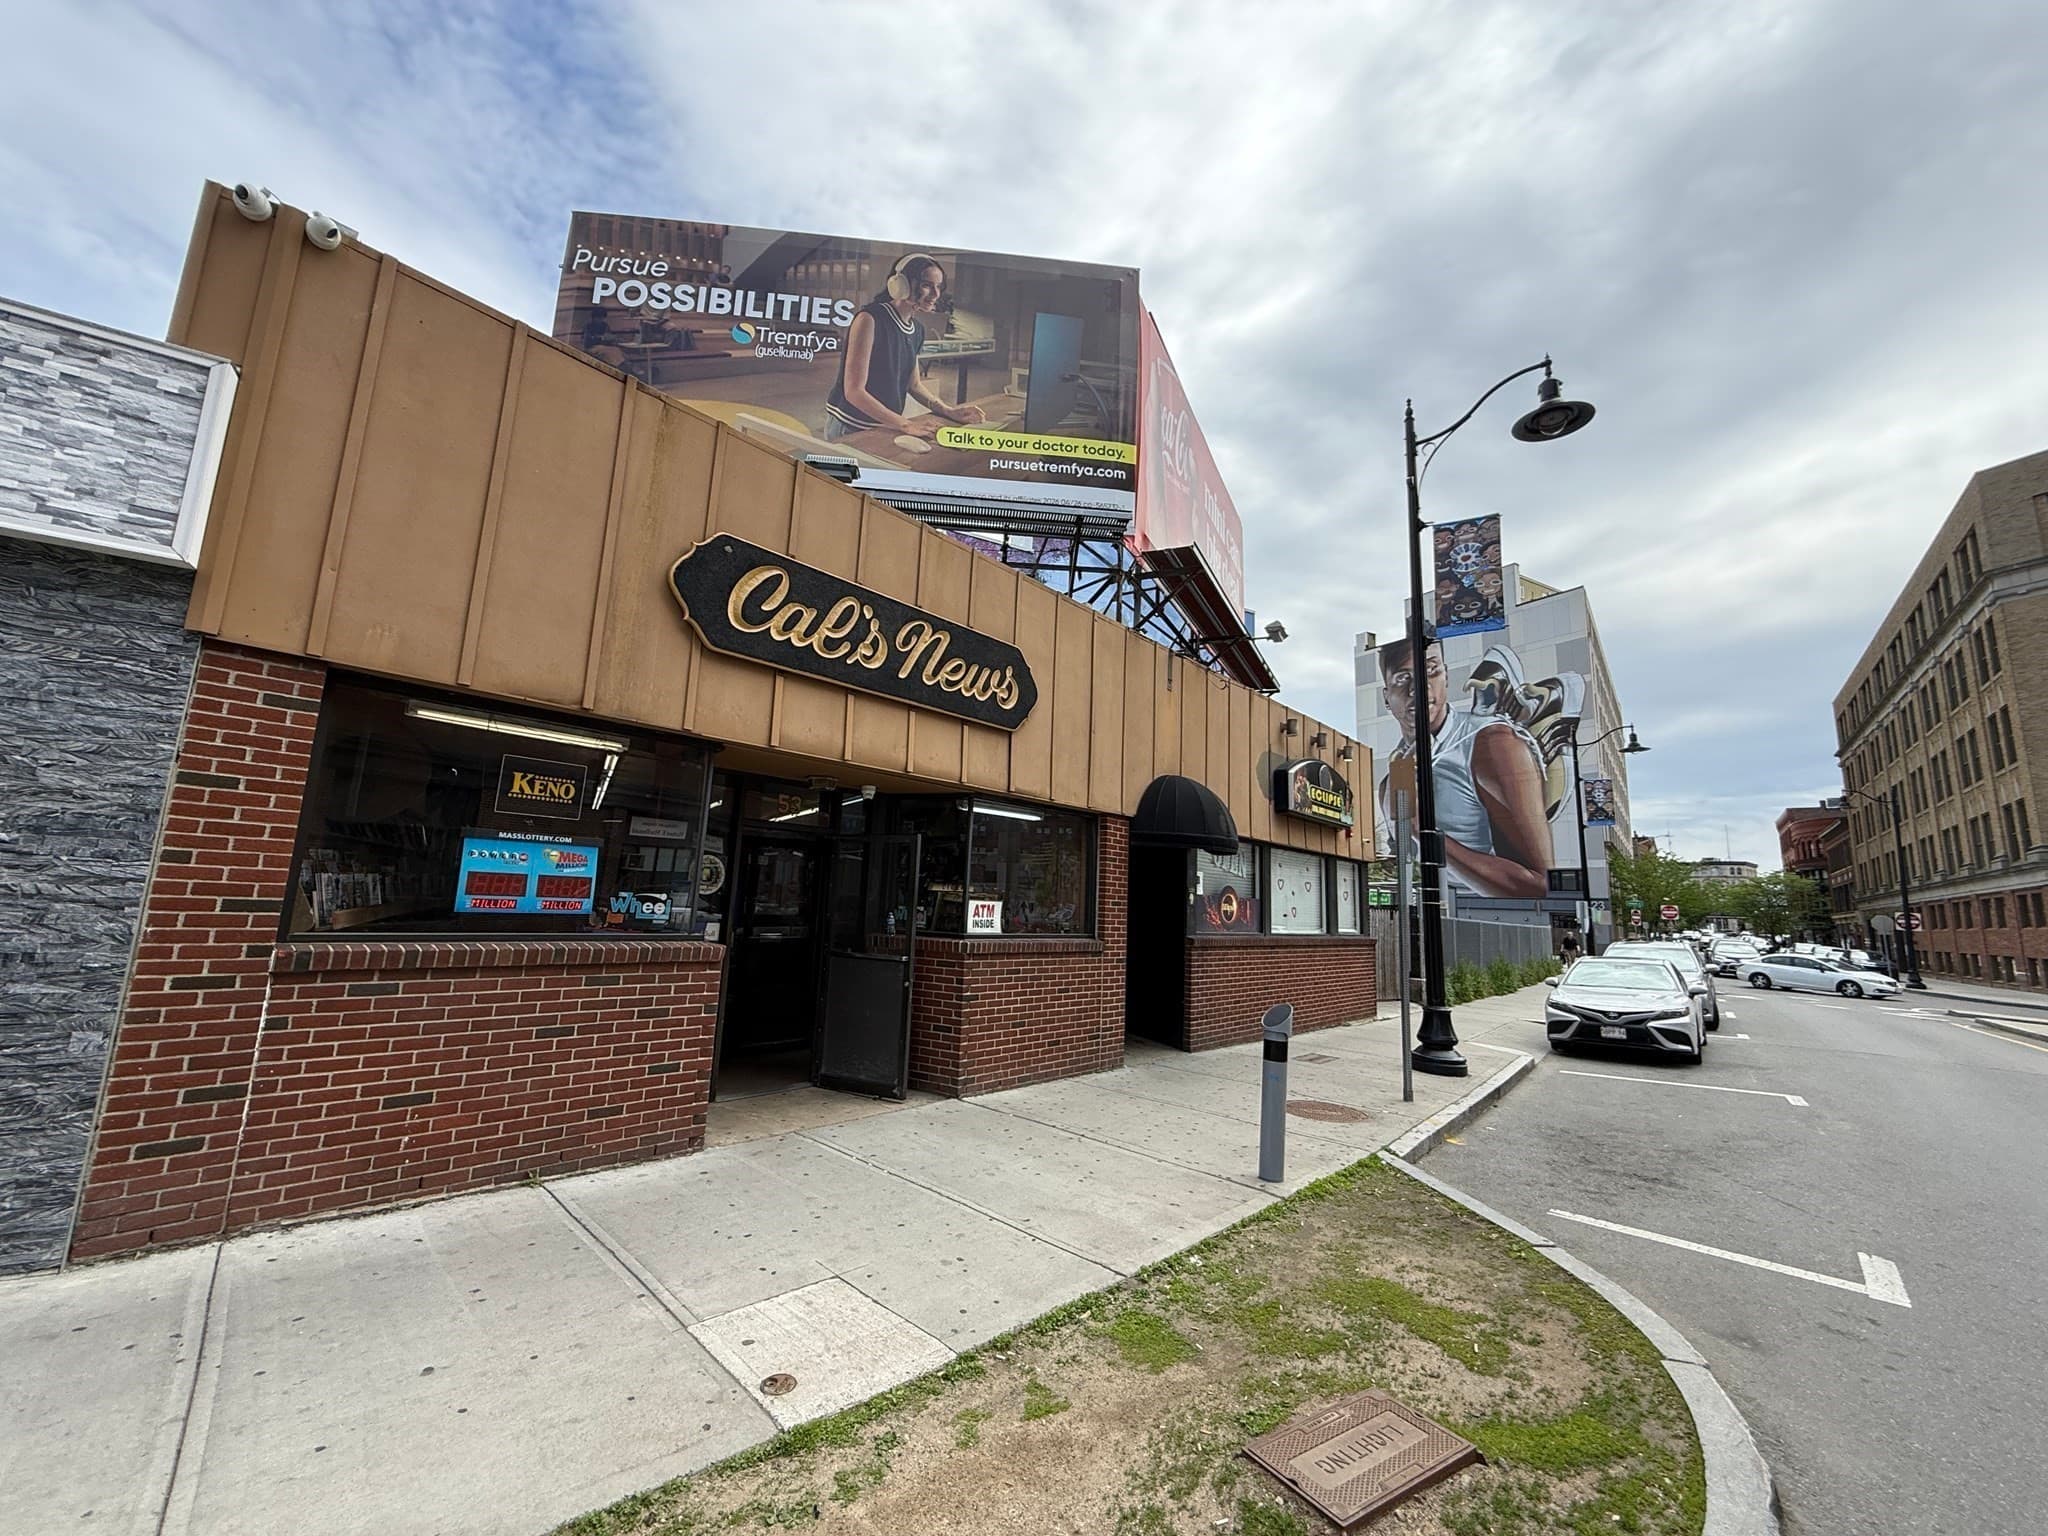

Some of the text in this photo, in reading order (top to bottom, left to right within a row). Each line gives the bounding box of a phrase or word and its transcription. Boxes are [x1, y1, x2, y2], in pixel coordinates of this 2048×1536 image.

[572, 249, 669, 277] Pursue
[591, 277, 856, 328] POSSIBILITIES
[755, 326, 838, 352] Tremfya
[755, 345, 814, 362] (guselkumab)
[946, 431, 1126, 460] Talk to your doctor today.
[989, 456, 1127, 480] pursuetremfya.com
[727, 565, 1020, 710] Cal's News
[509, 771, 576, 800] KENO
[777, 793, 801, 814] 53
[1311, 787, 1342, 808] ECLIPSE
[498, 831, 573, 844] MASSLOTTERY.COM
[557, 850, 589, 864] MEGA
[471, 899, 516, 909] MILLION
[541, 901, 582, 910] MILLION
[972, 904, 995, 918] ATM
[972, 919, 995, 929] INSIDE
[1314, 1424, 1405, 1474] LIGHTING
